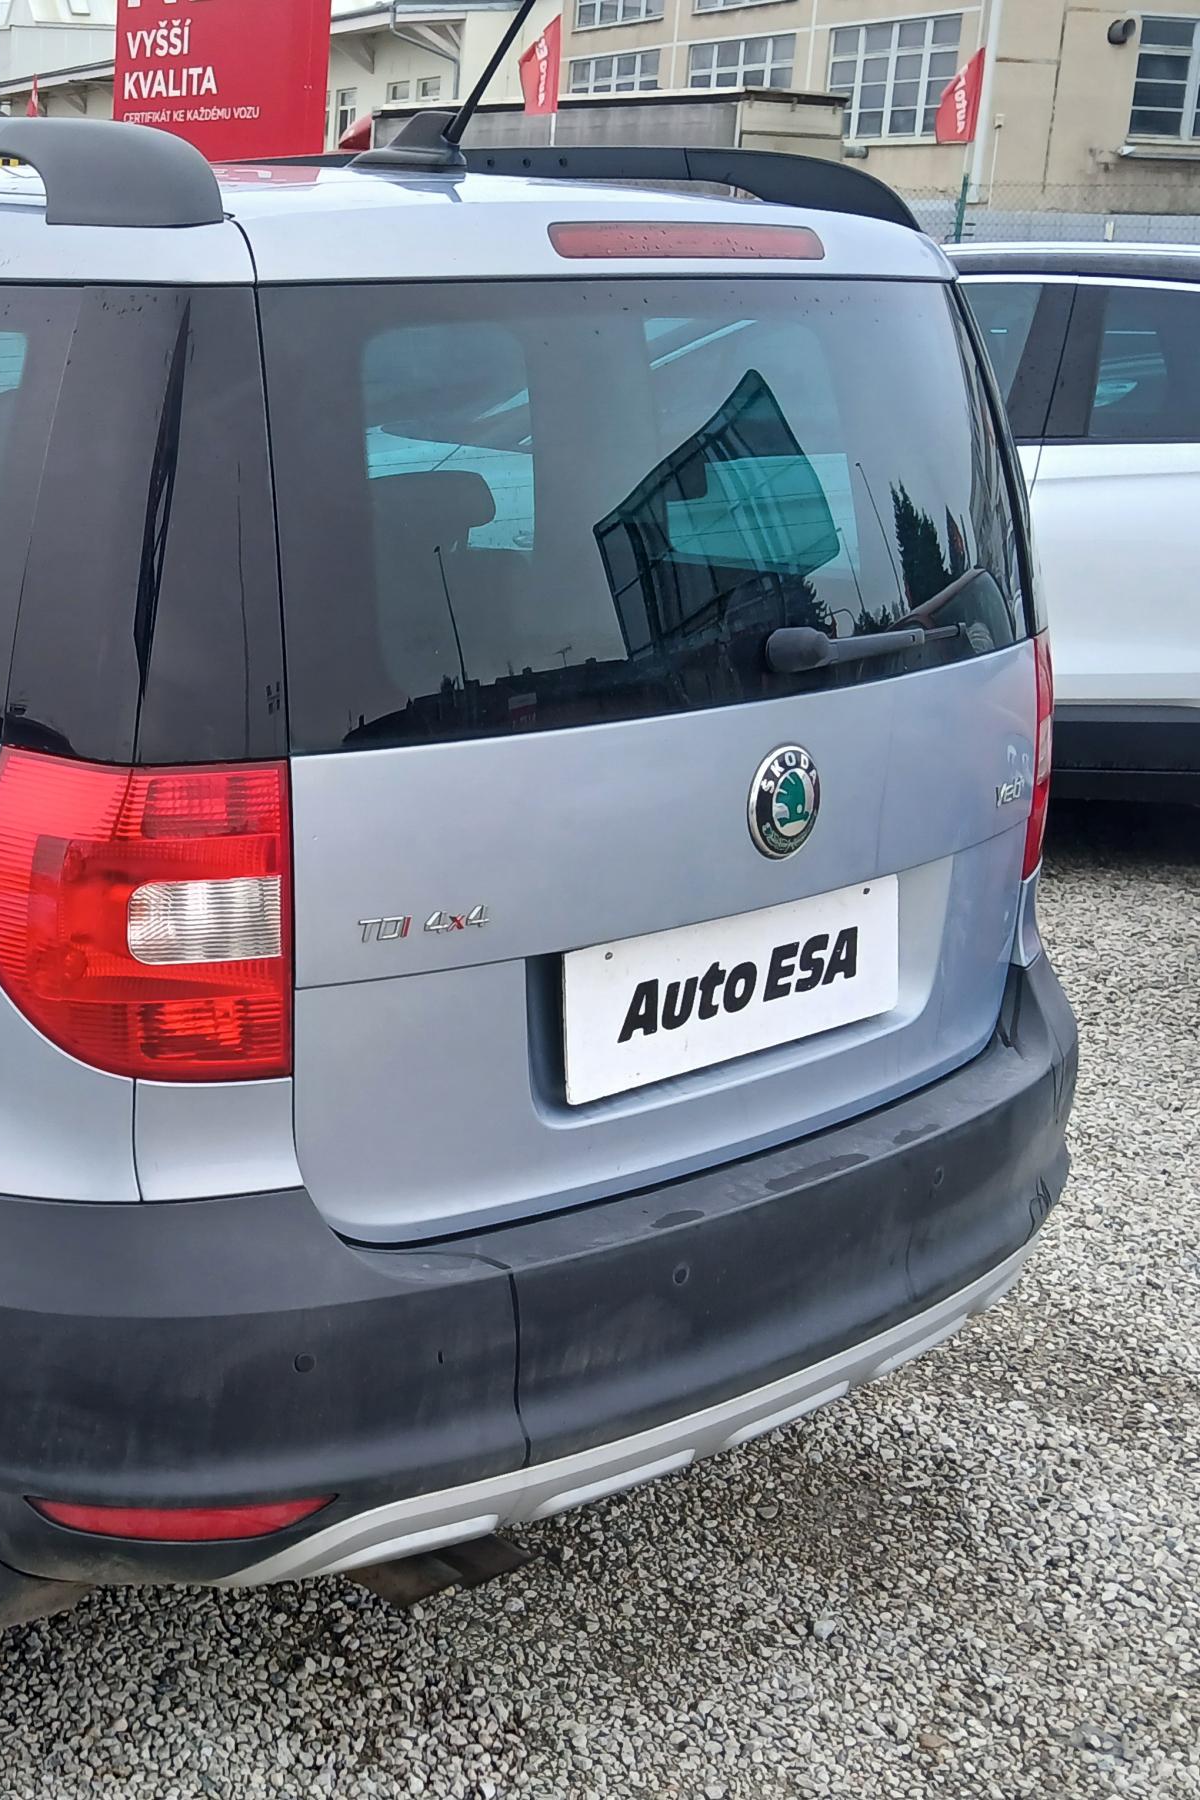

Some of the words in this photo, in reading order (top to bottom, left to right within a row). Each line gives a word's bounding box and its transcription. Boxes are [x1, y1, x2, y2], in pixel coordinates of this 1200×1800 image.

[126, 18, 193, 60] VYŠŠÍ
[123, 66, 218, 100] KVALITA
[123, 109, 171, 125] CERTIFIKÁT
[172, 108, 185, 122] KE
[186, 106, 231, 121] KAŽDÉMU
[232, 106, 260, 120] VOZU
[358, 914, 413, 943] TDI
[424, 904, 490, 935] 4x4
[617, 961, 758, 1044] Auto
[763, 926, 859, 1003] ESA
